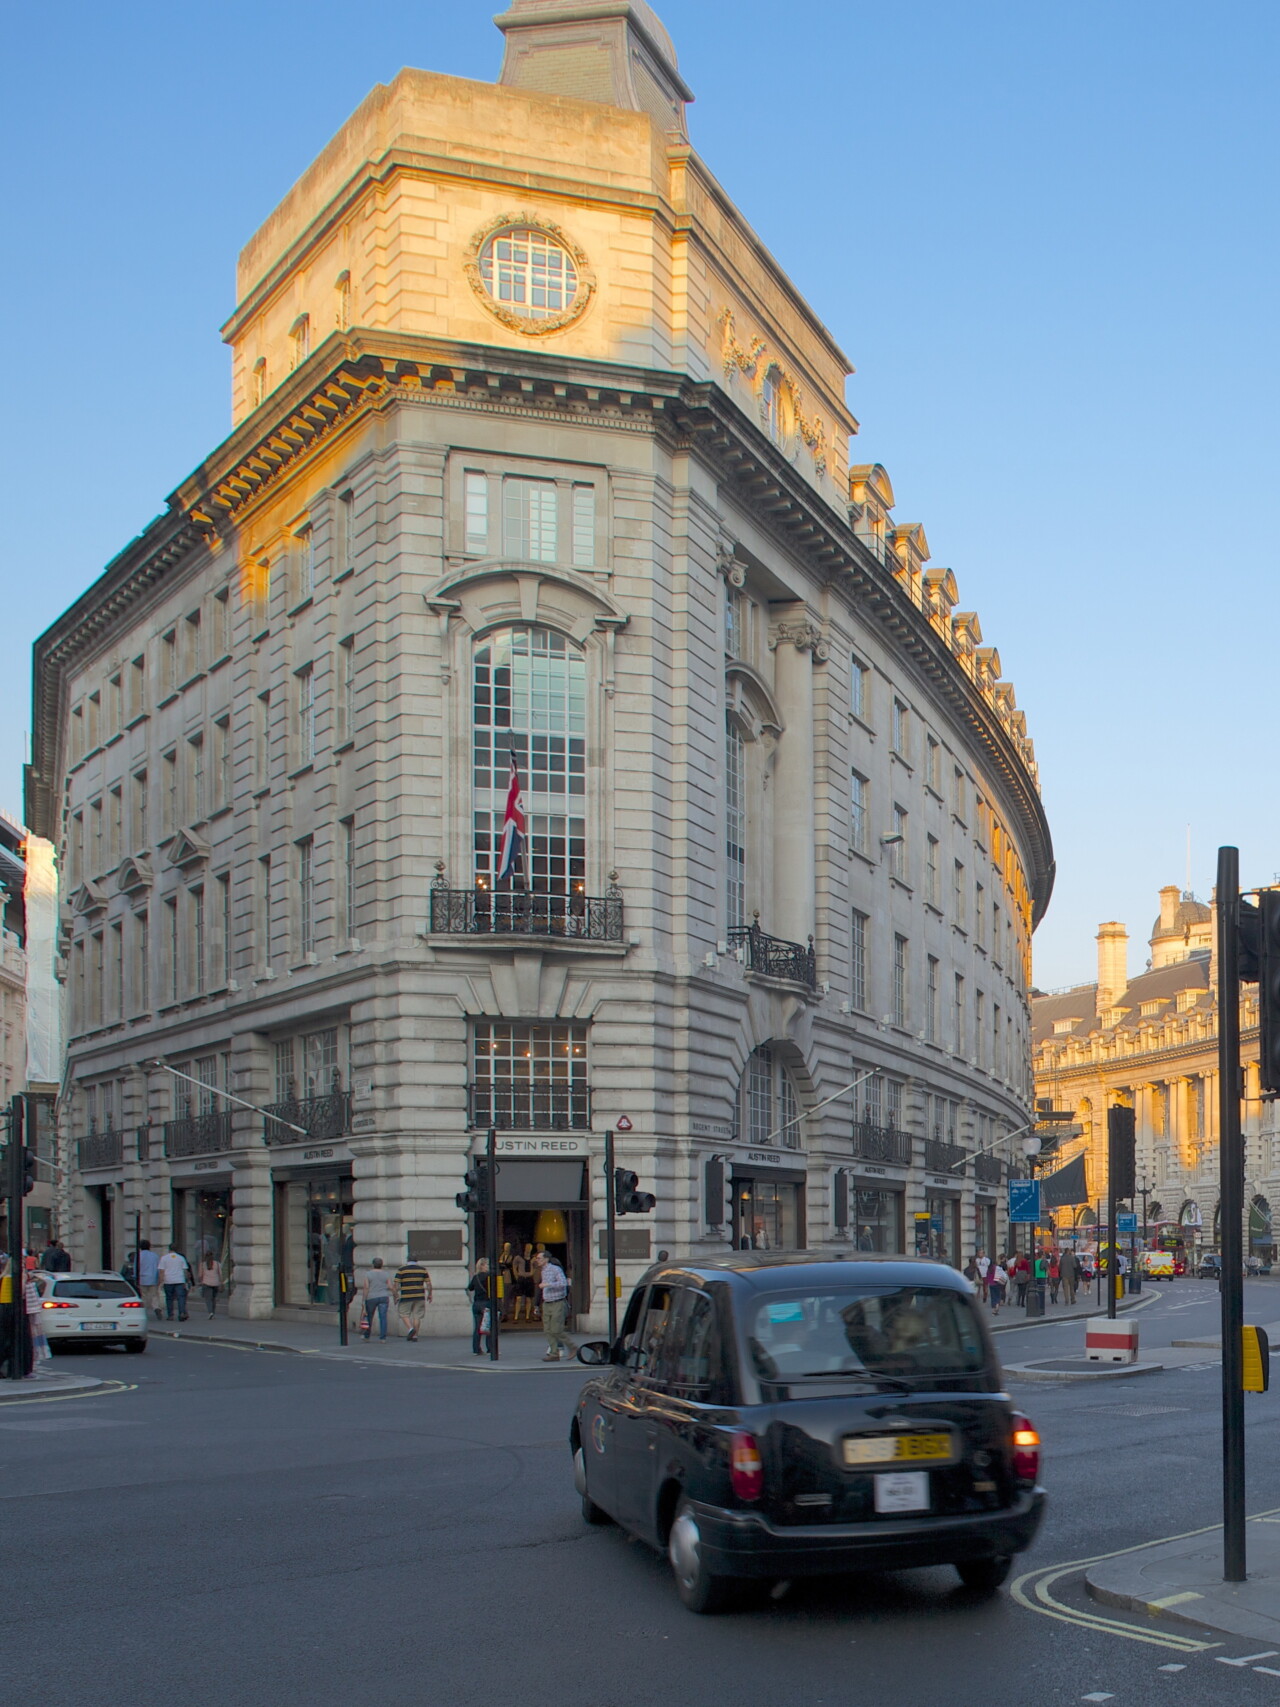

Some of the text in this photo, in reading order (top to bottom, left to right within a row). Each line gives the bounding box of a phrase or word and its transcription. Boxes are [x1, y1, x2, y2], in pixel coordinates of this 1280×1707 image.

[485, 1141, 578, 1151] USTIN REED
[303, 1149, 333, 1160] AUSTIN REED
[748, 1152, 780, 1163] AUSTIN REED
